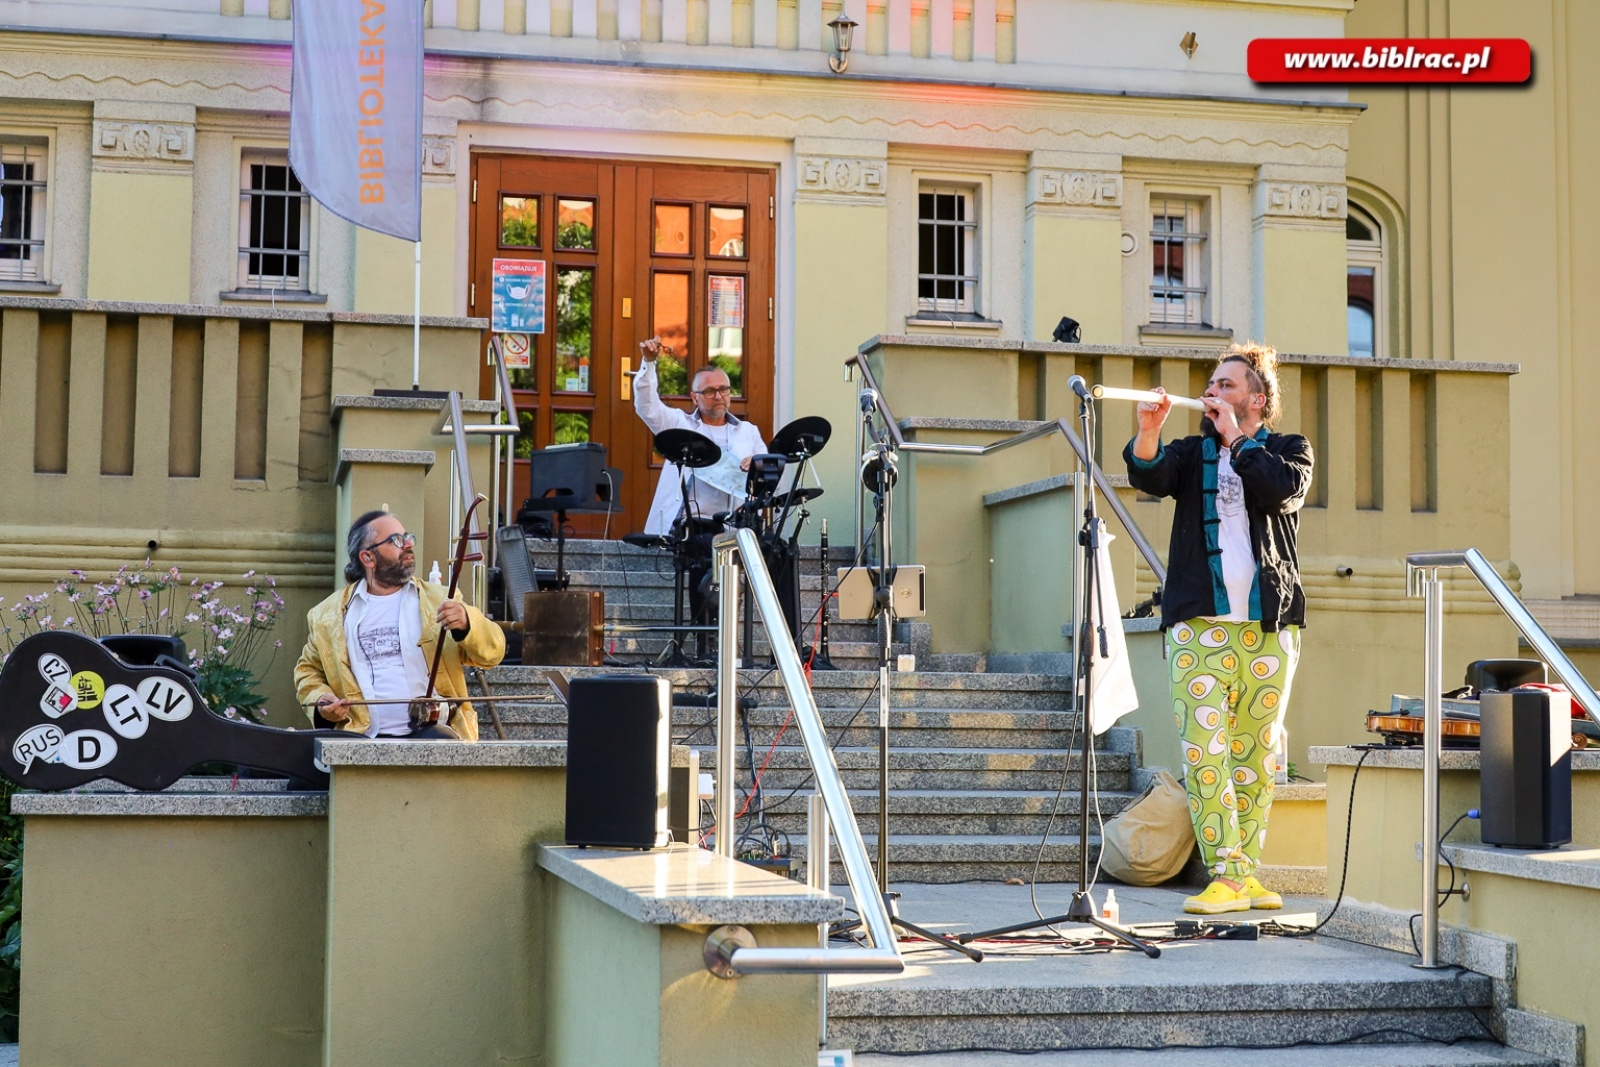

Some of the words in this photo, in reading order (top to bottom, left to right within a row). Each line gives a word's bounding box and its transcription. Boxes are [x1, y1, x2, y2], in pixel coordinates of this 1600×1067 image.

[43, 657, 68, 682] CZ
[109, 693, 143, 726] LT
[146, 681, 186, 715] LV
[17, 729, 60, 761] RUS
[77, 736, 102, 763] D
